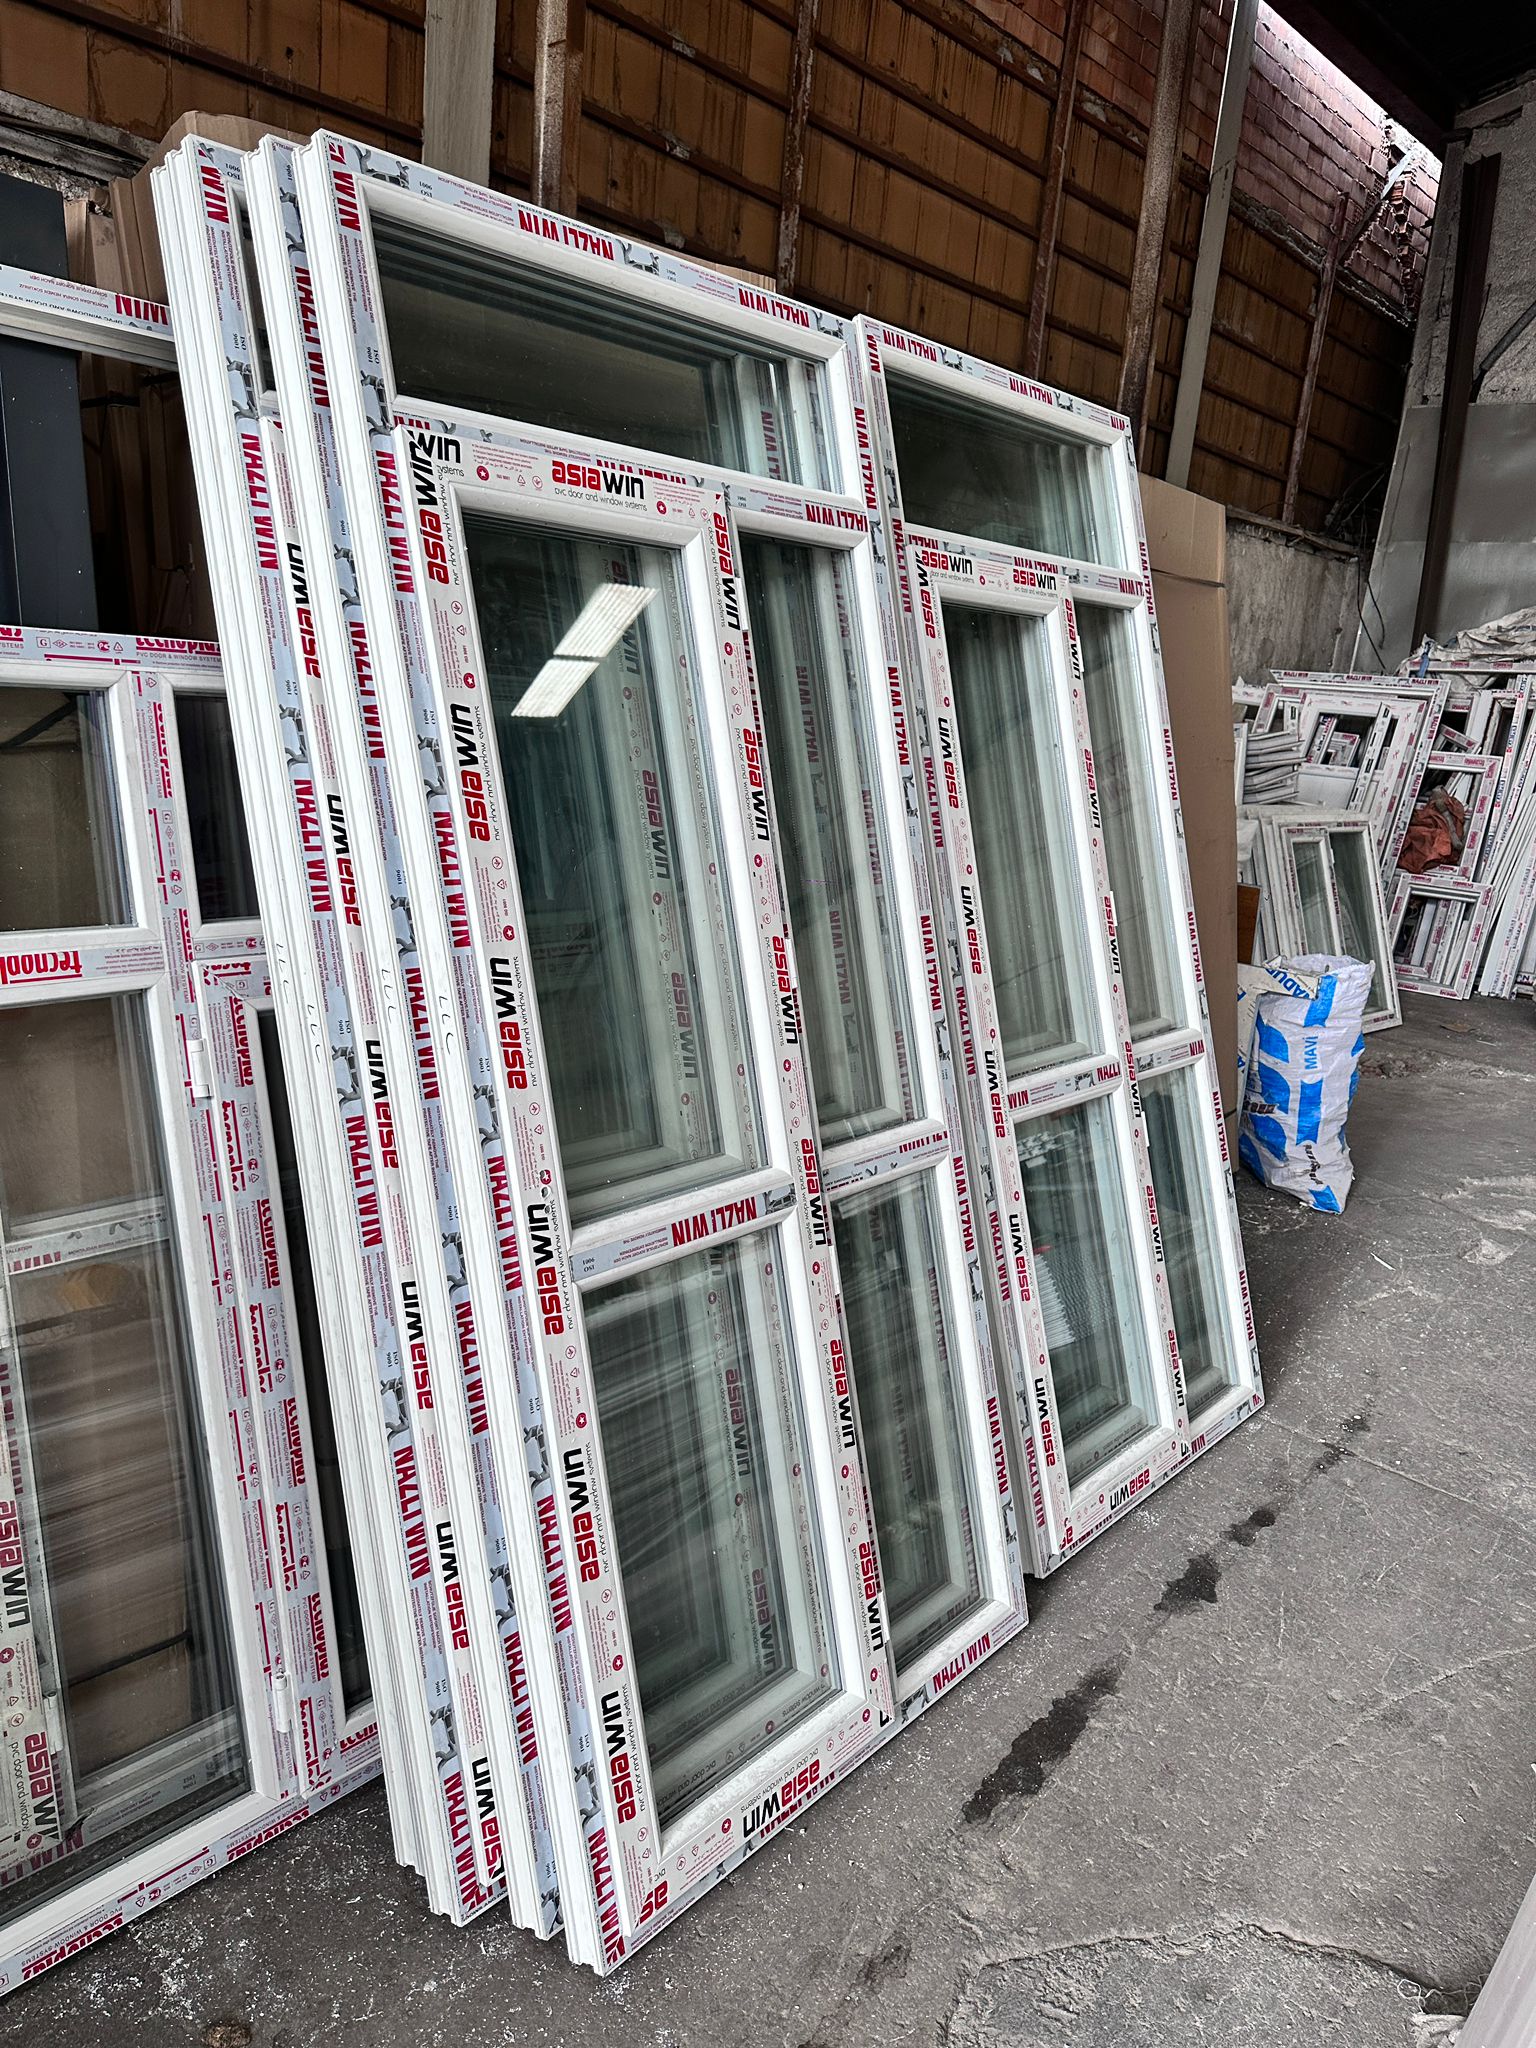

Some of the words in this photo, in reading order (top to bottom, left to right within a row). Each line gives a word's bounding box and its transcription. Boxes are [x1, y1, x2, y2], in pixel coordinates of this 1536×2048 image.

[333, 170, 361, 231] WIN
[518, 209, 559, 242] WIN
[738, 288, 769, 313] WIN
[867, 335, 881, 373] WIN
[883, 329, 906, 353] WIN
[308, 351, 330, 407] WIN
[1010, 377, 1027, 393] WIN
[854, 407, 869, 449] WIN
[552, 460, 645, 499] asiawin
[584, 489, 600, 502] and
[599, 493, 624, 507] window
[806, 504, 834, 525] WIN
[253, 515, 279, 569] WIN
[389, 536, 415, 594] WIN
[921, 549, 973, 575] asiawin
[714, 513, 740, 630] asiawin
[1012, 569, 1057, 590] asiawin
[286, 543, 321, 679] asiawin
[1064, 598, 1082, 680] asiawin
[888, 666, 901, 706] WIN
[362, 704, 386, 759] WIN
[450, 703, 490, 842] asiawin
[477, 741, 491, 777] window
[743, 728, 770, 840] asiawin
[937, 716, 959, 809] asiawin
[483, 778, 494, 798] and
[1083, 748, 1101, 829] asiawin
[304, 859, 333, 912] WIN
[326, 794, 362, 926] asiawin
[447, 892, 472, 949] WIN
[920, 915, 935, 955] WIN
[960, 886, 981, 975] asiawin
[1103, 896, 1121, 974] asiawin
[772, 936, 798, 1044] asiawin
[223, 1009, 231, 1027] DOOR
[489, 957, 528, 1090] asiawin
[227, 1033, 236, 1060] WINDOW
[417, 1045, 440, 1100] WIN
[960, 1039, 975, 1076] WIN
[1189, 1040, 1205, 1056] WIN
[1303, 1036, 1318, 1070] MAVİ
[230, 1059, 241, 1088] SYSTEMS
[984, 1050, 1006, 1138] asiawin
[1007, 1090, 1029, 1110] WIN
[1124, 1041, 1141, 1118] asiawin
[366, 1040, 399, 1169] asiawin
[1212, 1091, 1222, 1119] WIN
[795, 1154, 804, 1173] door
[797, 1174, 806, 1190] and
[953, 1157, 966, 1200] WIN
[799, 1191, 811, 1220] window
[801, 1139, 827, 1246] asiawin
[357, 1191, 383, 1248] WIN
[671, 1213, 711, 1247] WIN
[803, 1221, 815, 1250] systems
[1146, 1185, 1164, 1262] asiawin
[498, 1237, 523, 1291] WIN
[527, 1204, 564, 1336] asiawin
[997, 1261, 1011, 1301] WIN
[1008, 1213, 1031, 1302] asiawin
[1239, 1270, 1249, 1299] WIN
[401, 1281, 434, 1410] asiawin
[1168, 1329, 1185, 1407] asiawin
[466, 1379, 488, 1435] WIN
[830, 1339, 855, 1448] asiawin
[987, 1397, 1000, 1438] WIN
[1034, 1377, 1055, 1466] asiawin
[563, 1447, 600, 1582] asiawin
[1110, 1469, 1149, 1510] asiawin
[405, 1521, 431, 1580] WIN
[436, 1521, 470, 1651] asiawin
[550, 1572, 573, 1633] WIN
[859, 1542, 884, 1651] asiawin
[967, 1632, 990, 1665] WIN
[9, 1741, 19, 1758] pvc
[516, 1704, 538, 1765] WIN
[601, 1691, 637, 1824] asiawin
[13, 1759, 23, 1779] door
[16, 1781, 26, 1799] and
[743, 1759, 820, 1838] asiawin
[53, 1925, 85, 1948] WINDOW
[91, 1912, 109, 1926] DOOR
[108, 1904, 123, 1916] PVC
[20, 1944, 54, 1968] SYSTEMS
